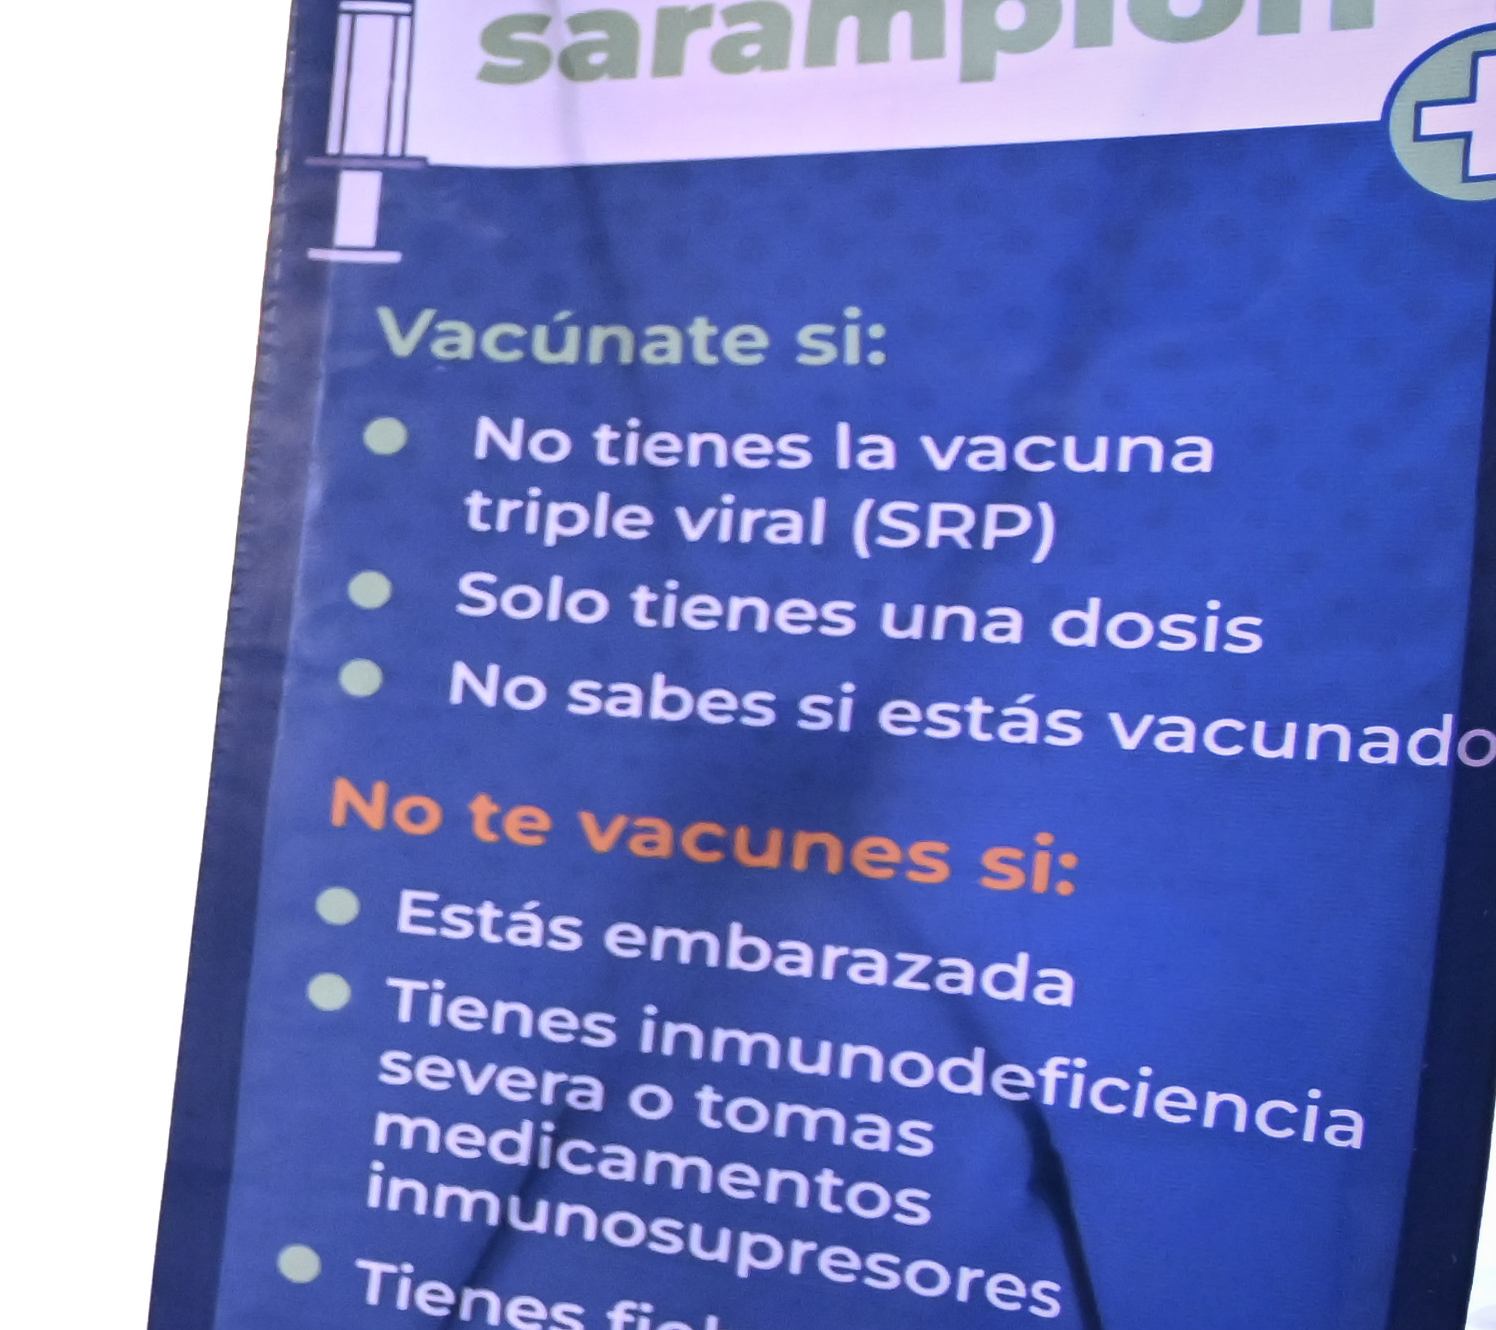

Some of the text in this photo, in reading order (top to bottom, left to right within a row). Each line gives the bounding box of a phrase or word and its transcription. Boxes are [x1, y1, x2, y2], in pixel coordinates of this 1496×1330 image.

[378, 306, 887, 368] Vacúnate si:
[474, 416, 1215, 474] No tienes la vacuna
[465, 488, 1057, 564] triple viral (SRP)
[456, 571, 1264, 654] Solo tienes una dosis
[449, 662, 1496, 769] No sabes si estás vacunado
[331, 777, 1078, 897] No te vacunes si:
[396, 889, 1075, 1007] Estás embarazada
[379, 1047, 936, 1158] severa o tomas
[388, 977, 1365, 1151] Tienes inmunodeficiencia
[373, 1105, 933, 1228] medicamentos
[366, 1162, 1063, 1320] inmunosupresores
